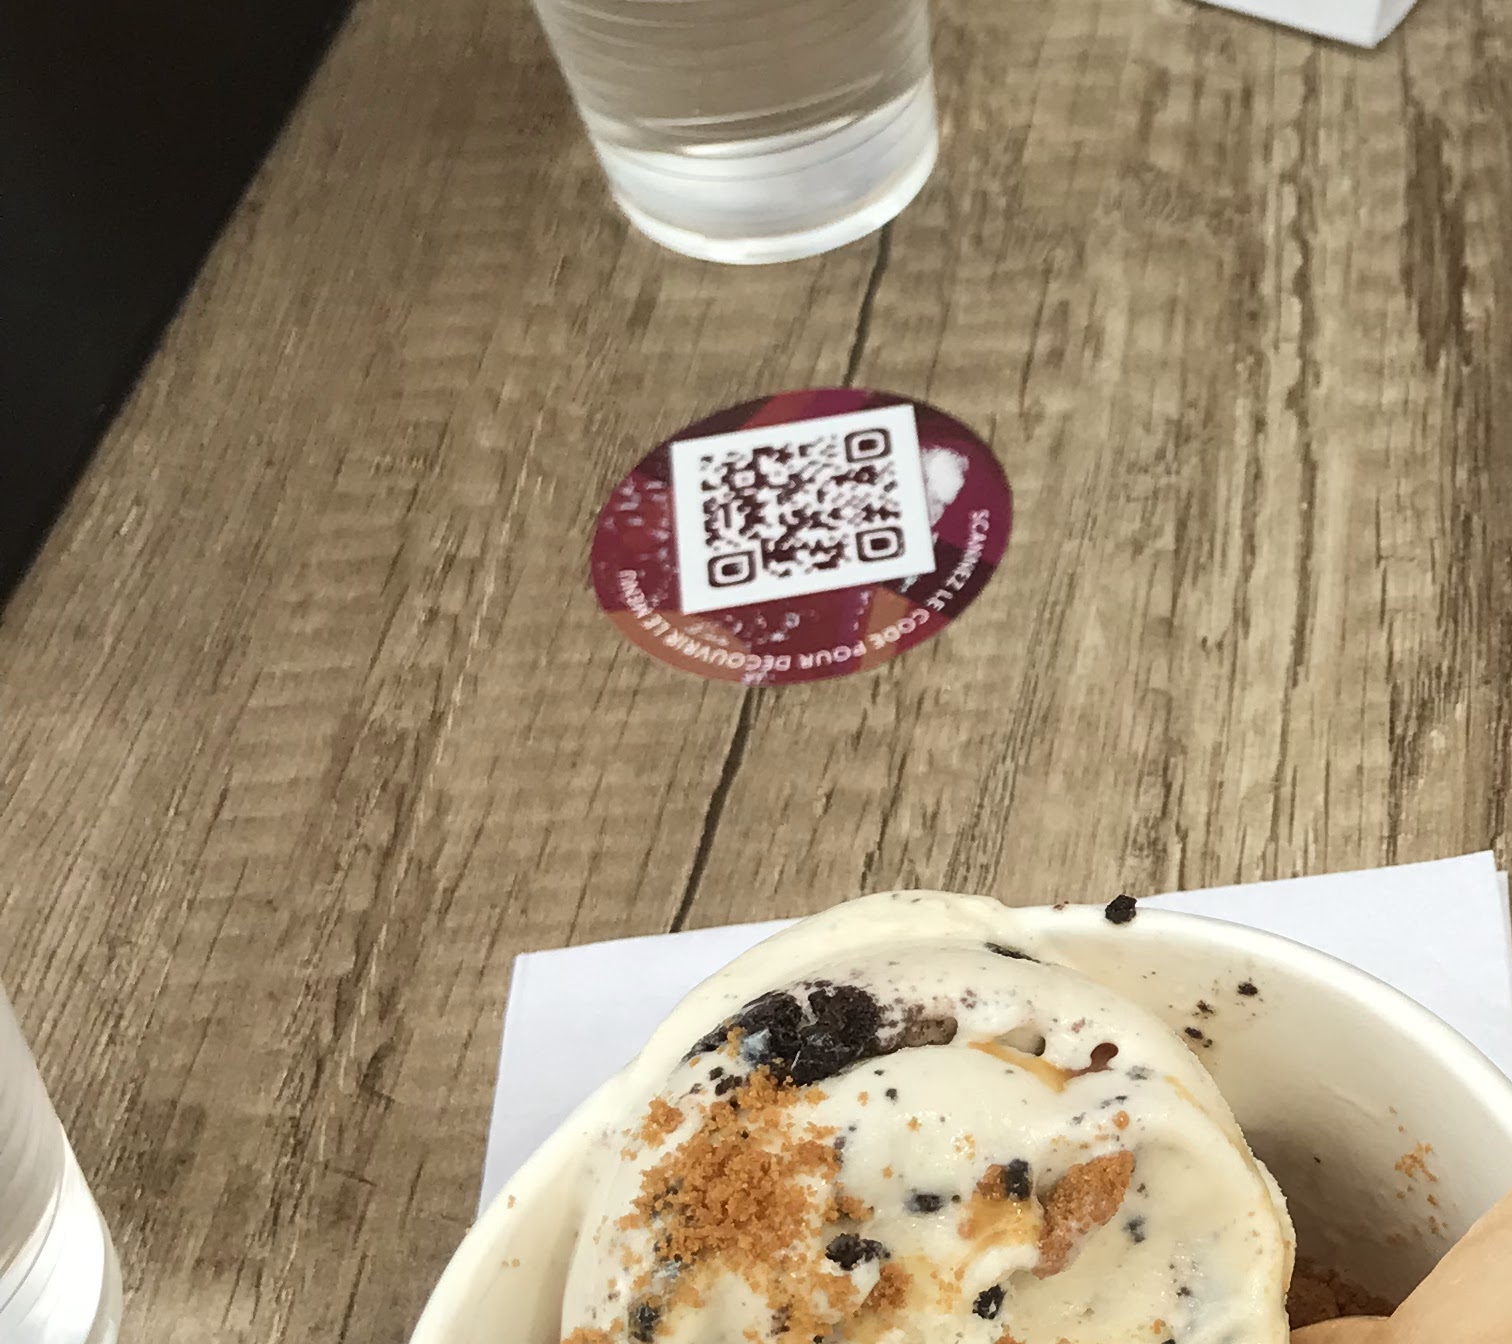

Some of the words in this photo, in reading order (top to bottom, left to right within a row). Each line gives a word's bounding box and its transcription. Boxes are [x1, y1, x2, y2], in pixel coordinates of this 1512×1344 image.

[944, 509, 990, 591] SCANNEZ
[618, 569, 653, 619] MENU
[925, 588, 954, 612] LE
[641, 613, 672, 637] LE
[867, 608, 930, 650] CODE
[798, 639, 868, 670] POUR
